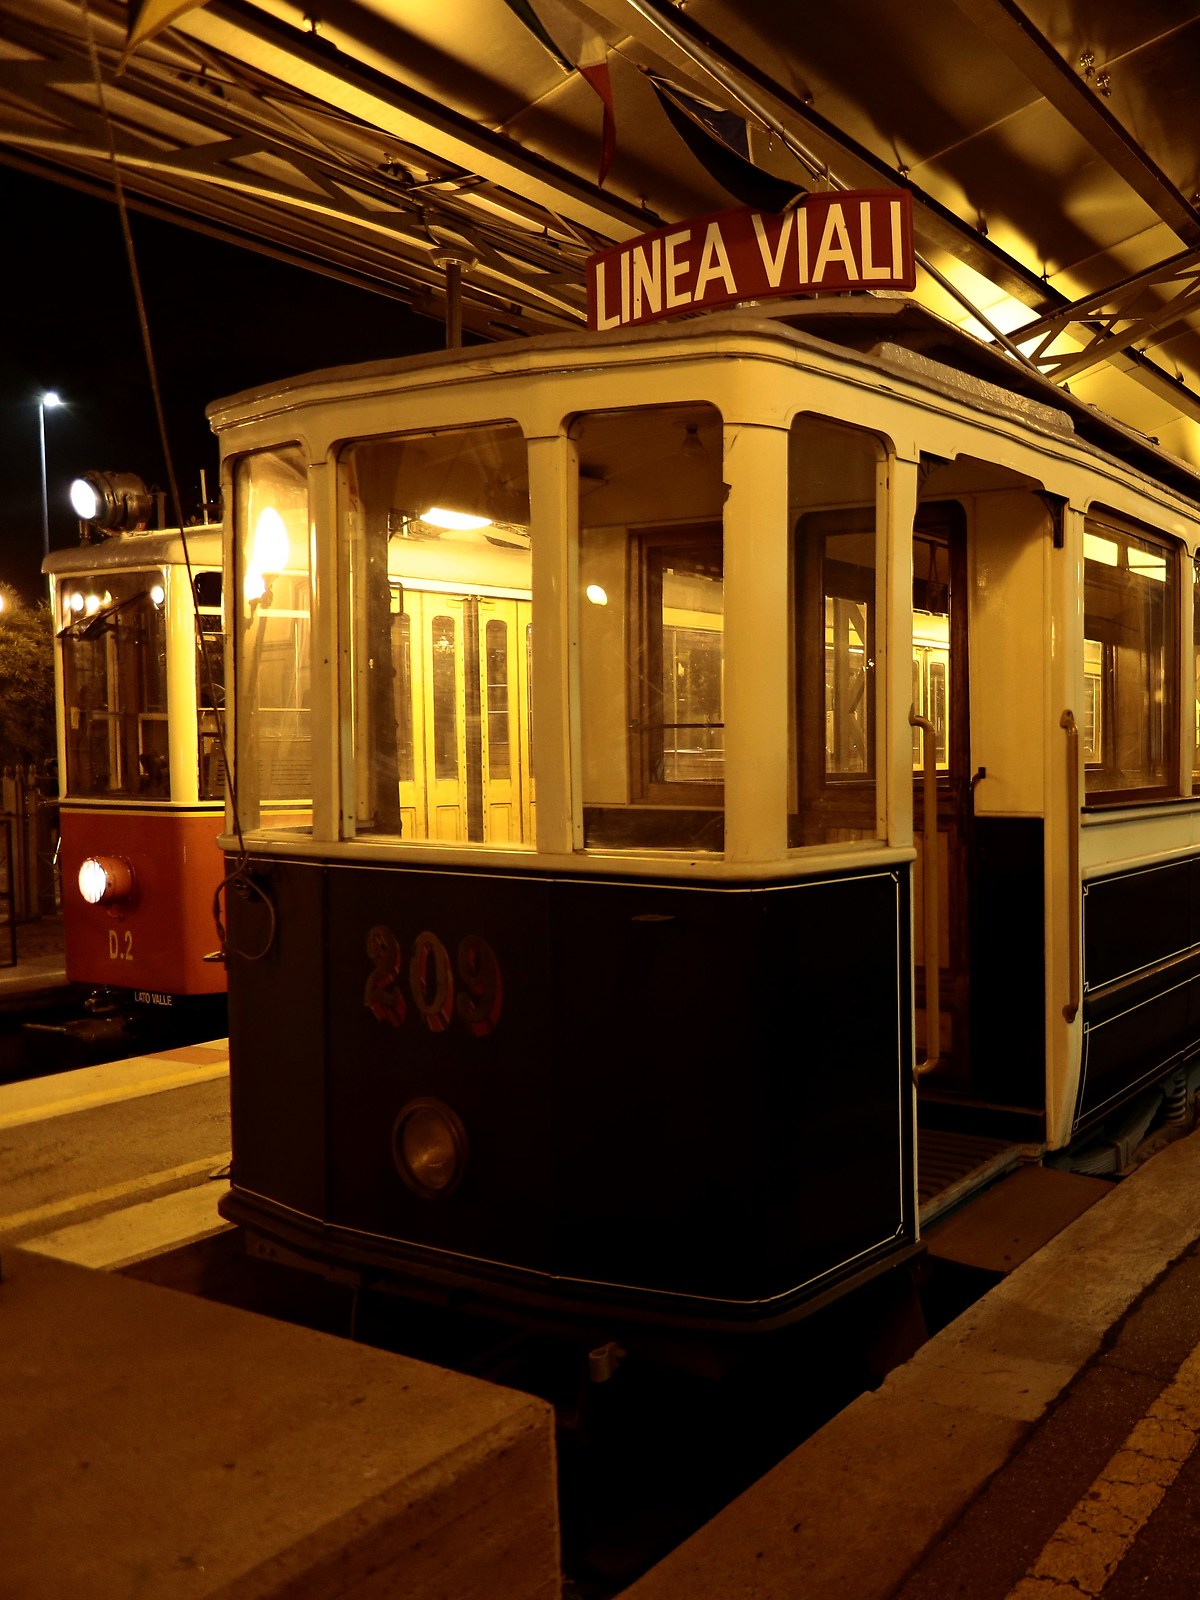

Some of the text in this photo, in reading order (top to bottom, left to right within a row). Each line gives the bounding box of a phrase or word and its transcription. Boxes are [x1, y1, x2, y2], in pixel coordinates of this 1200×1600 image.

[595, 201, 903, 331] LINEA VIALI
[108, 929, 133, 960] D.2
[364, 924, 504, 1037] 209
[134, 991, 172, 1006] LATO VALLE
